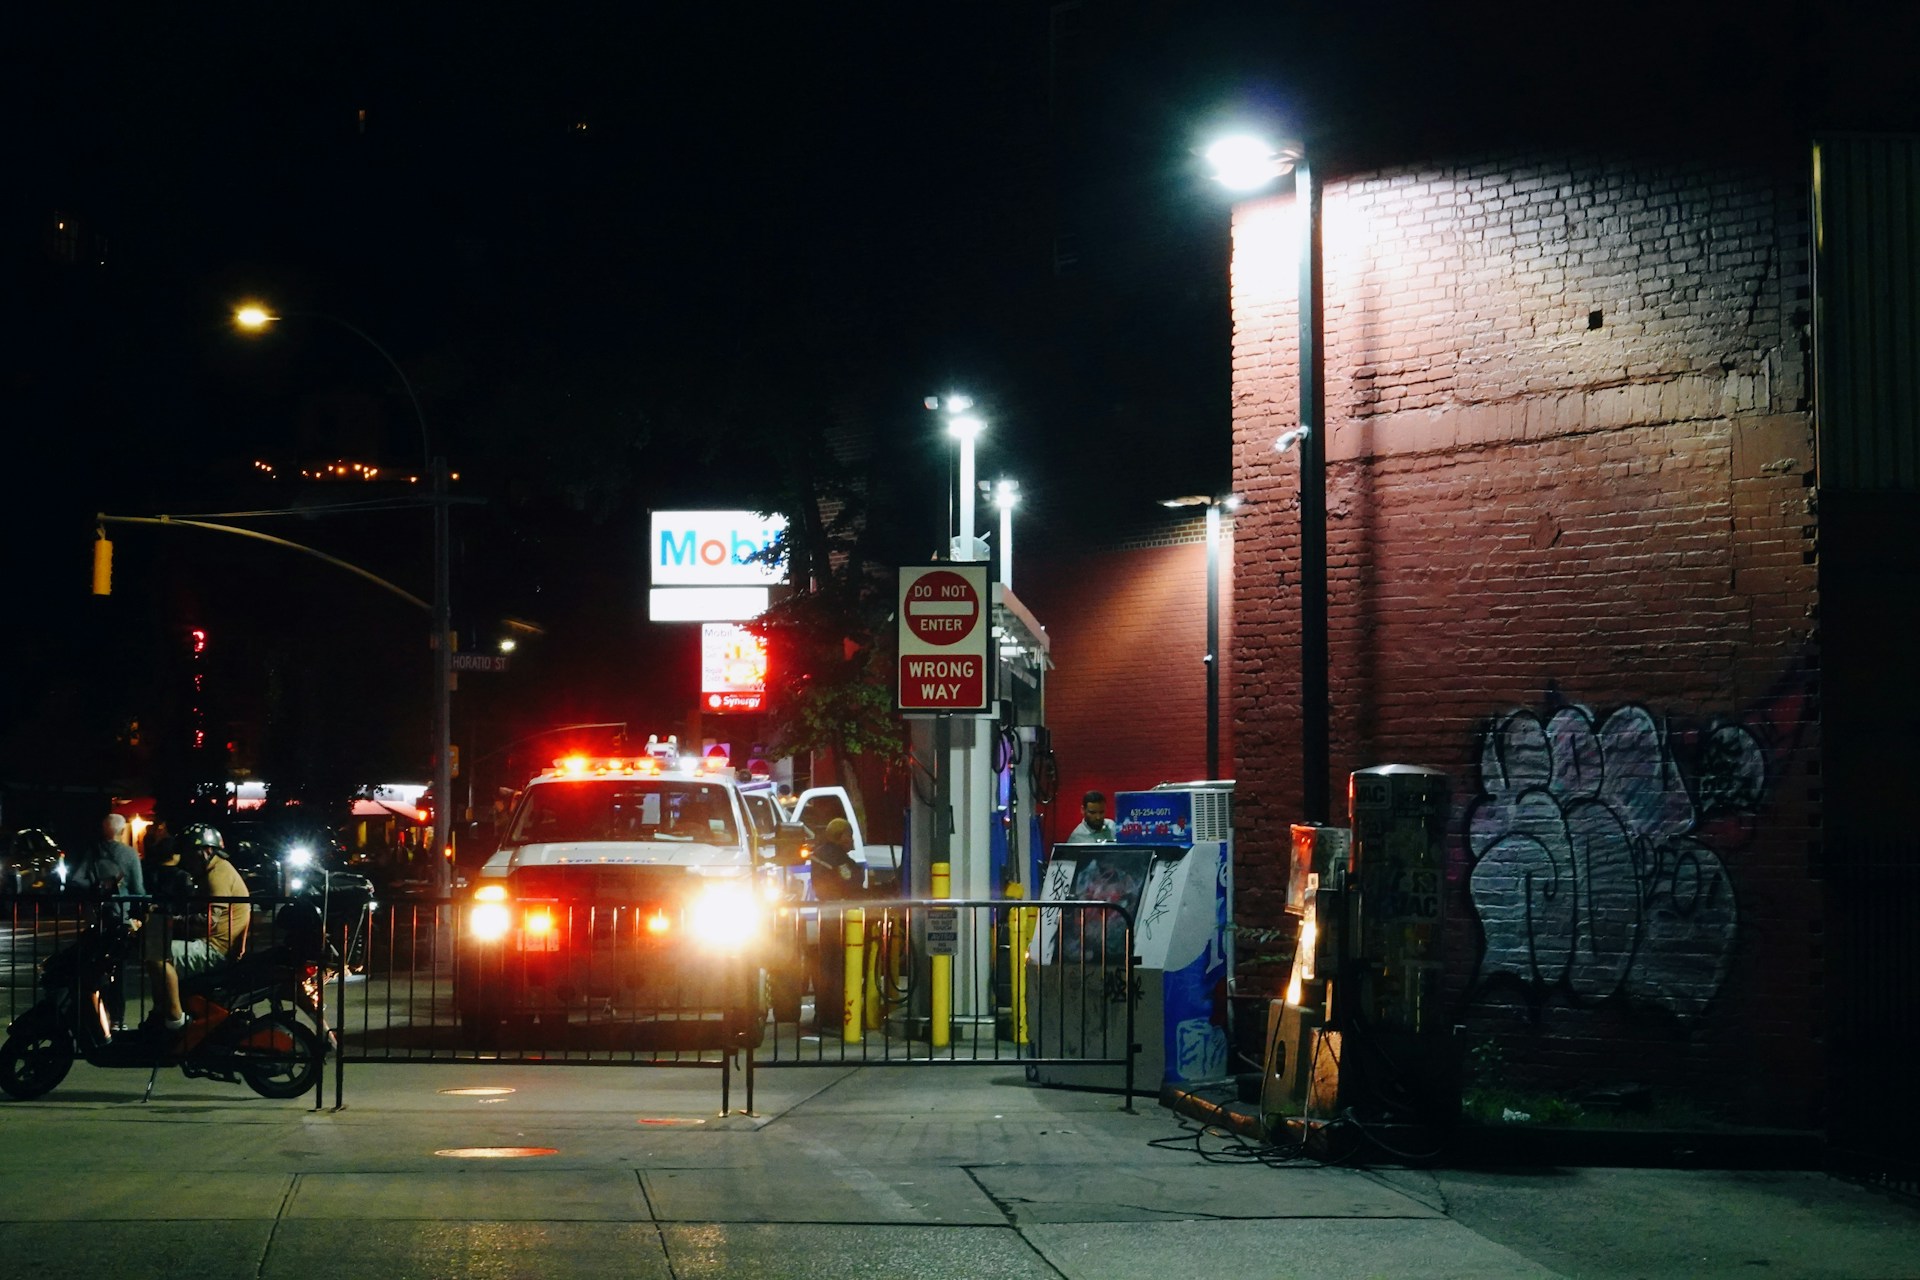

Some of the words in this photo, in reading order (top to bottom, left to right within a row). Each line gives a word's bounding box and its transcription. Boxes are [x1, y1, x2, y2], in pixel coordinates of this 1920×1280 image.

[660, 529, 782, 566] Mobil
[914, 585, 932, 598] DO
[941, 585, 967, 598] NOT
[920, 618, 962, 631] ENTER
[452, 655, 491, 670] HORATIO
[495, 656, 506, 670] ST
[909, 661, 974, 678] WRONG
[921, 683, 961, 700] WAY
[723, 695, 760, 708] Synergy
